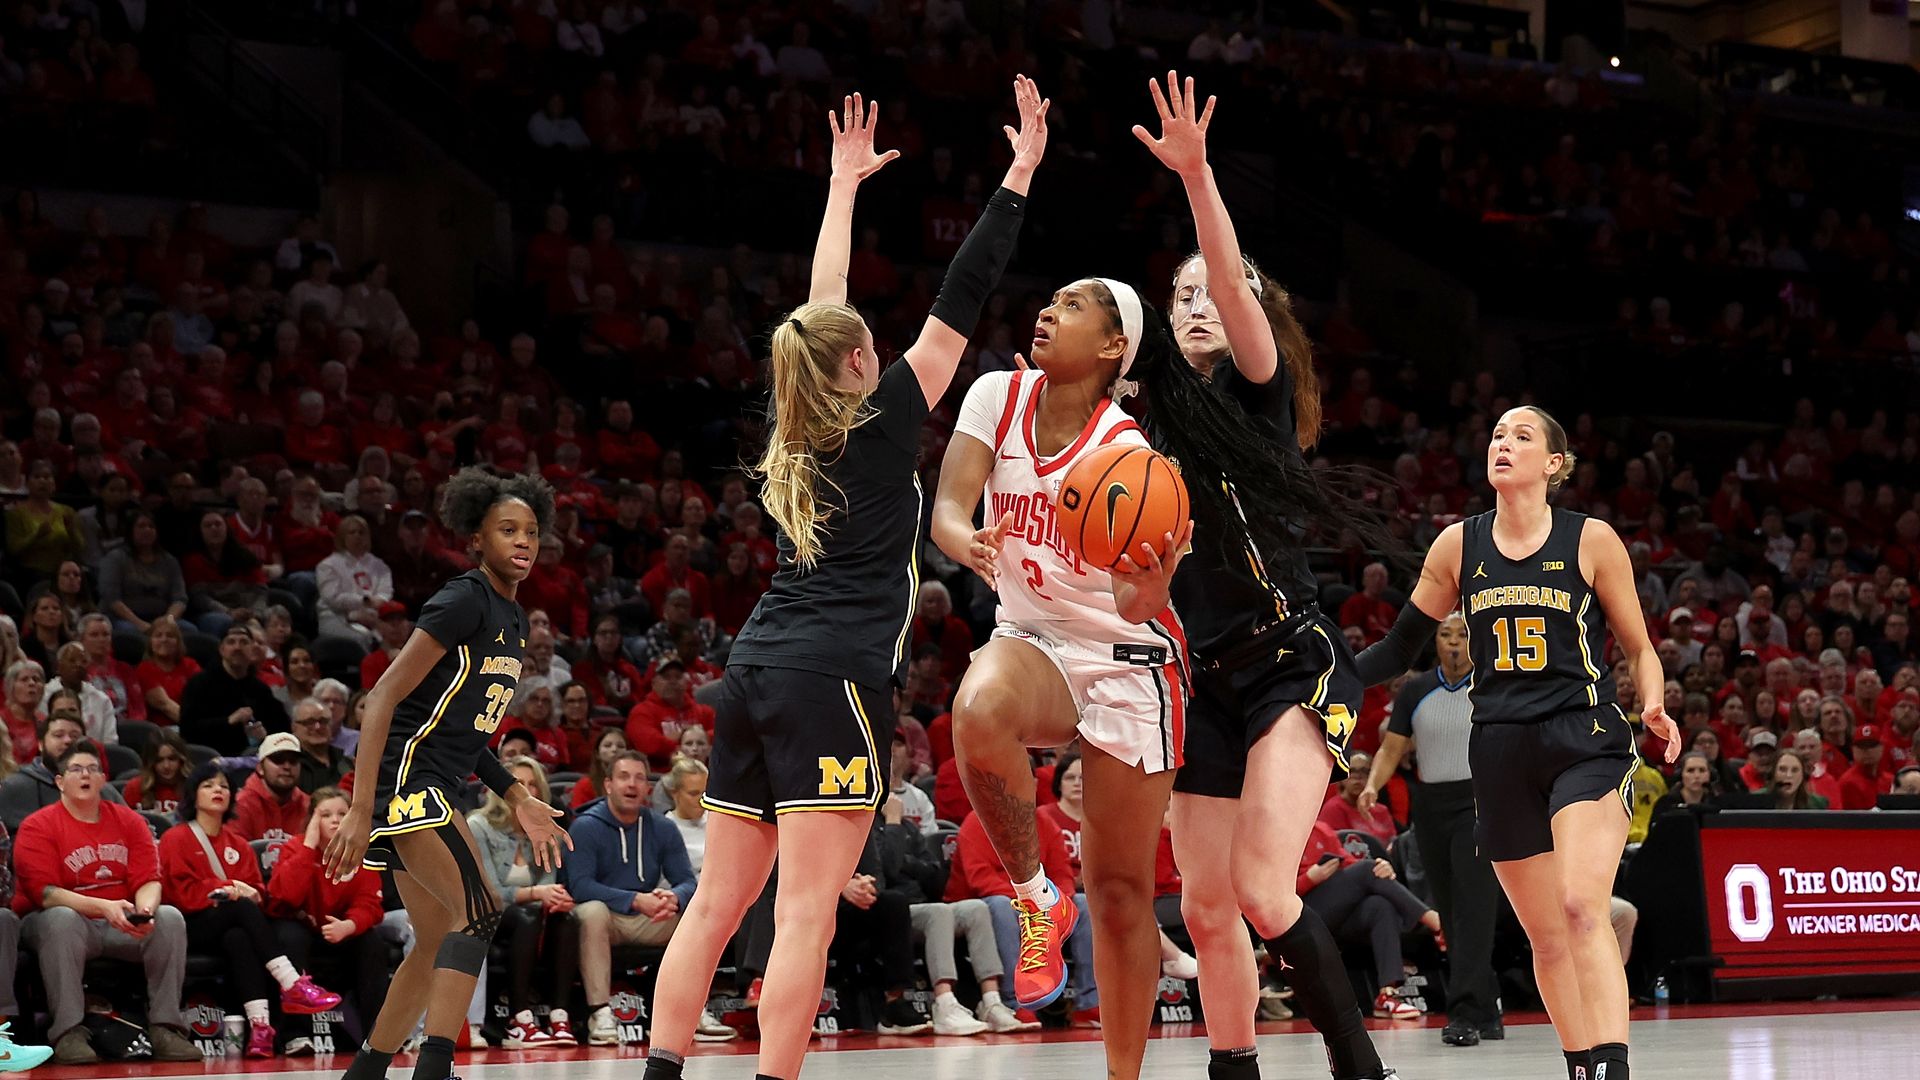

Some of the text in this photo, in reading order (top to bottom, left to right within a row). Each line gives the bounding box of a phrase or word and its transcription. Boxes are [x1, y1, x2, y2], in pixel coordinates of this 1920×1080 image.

[1021, 558, 1054, 601] 2
[1470, 585, 1571, 615] MICHIGAN
[1492, 617, 1547, 671] 15
[474, 682, 515, 734] 33
[819, 756, 868, 795] M
[387, 790, 427, 825] M
[1724, 863, 1774, 942] O
[1786, 913, 1920, 935] WEXNER MEDICA
[1160, 1005, 1192, 1022] AA13
[617, 1024, 643, 1042] AA7
